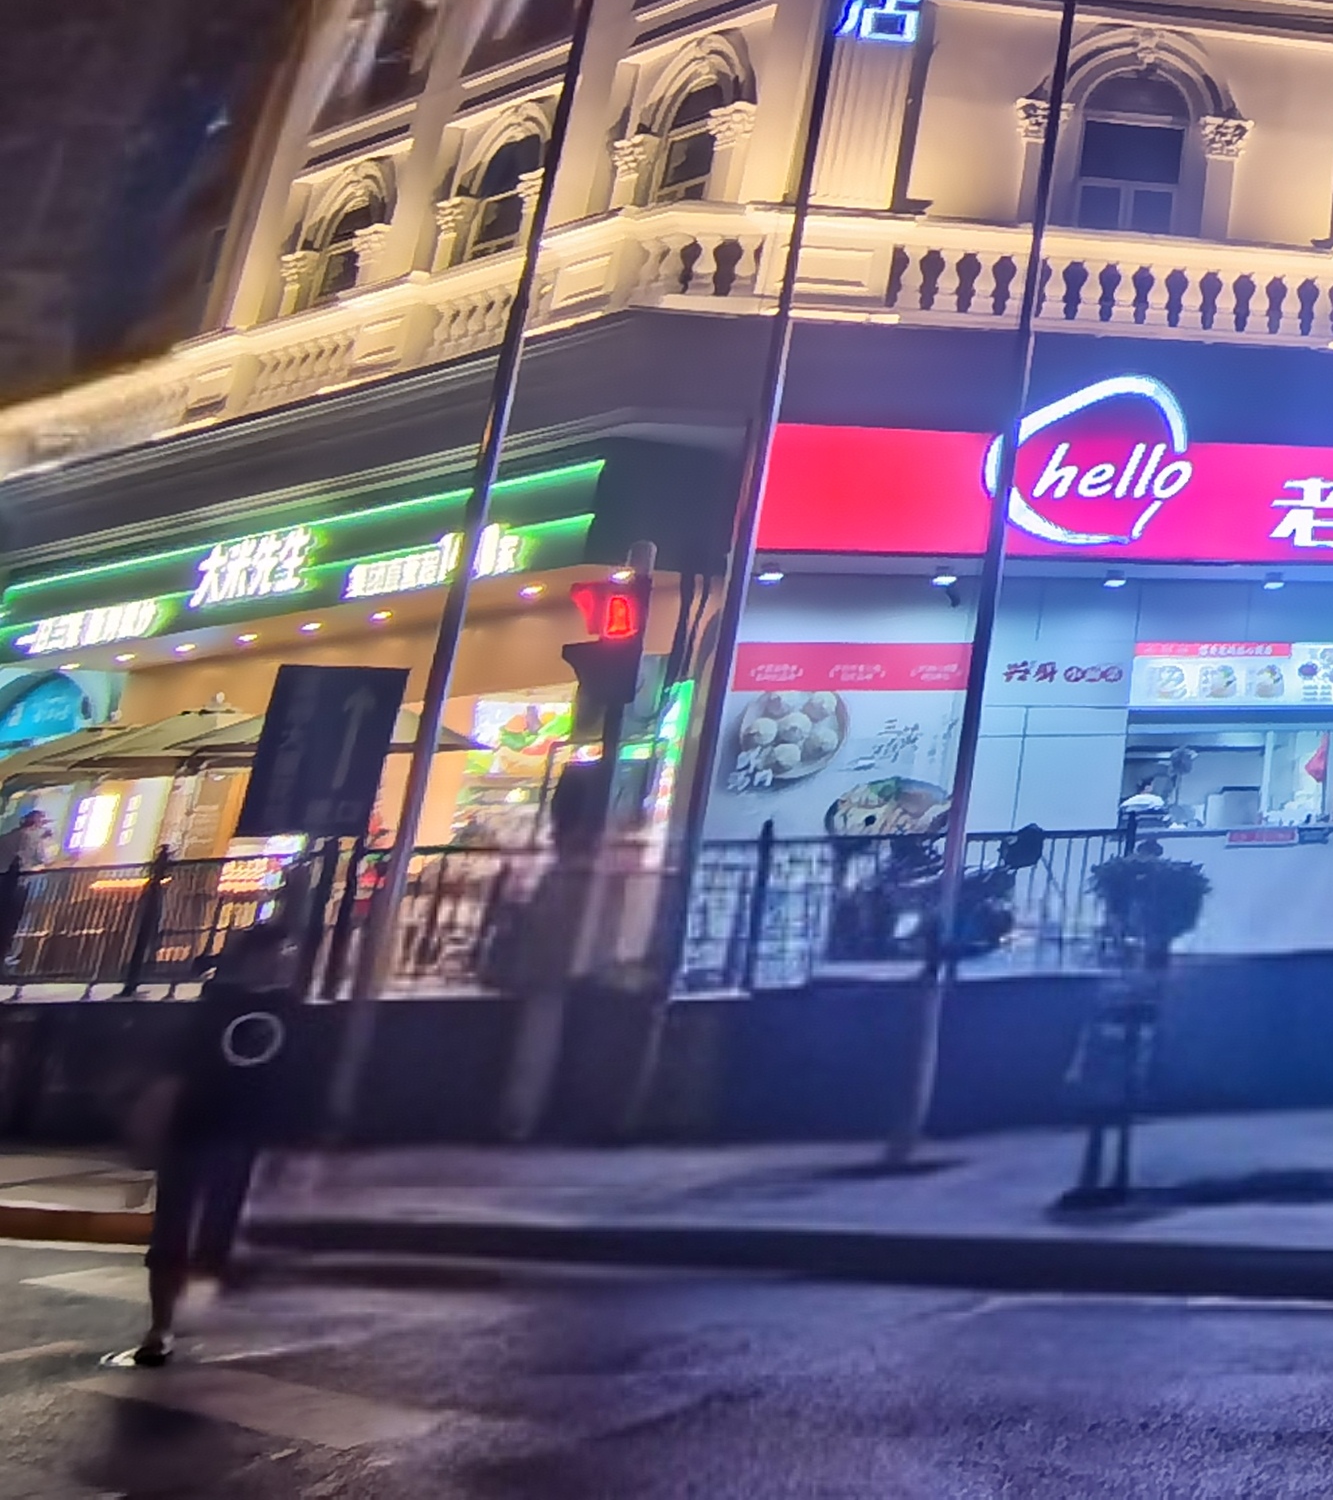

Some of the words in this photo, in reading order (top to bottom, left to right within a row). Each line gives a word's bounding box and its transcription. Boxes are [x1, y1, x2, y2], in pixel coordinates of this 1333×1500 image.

[1032, 441, 1192, 500] hello
[188, 525, 312, 608] 大米先生
